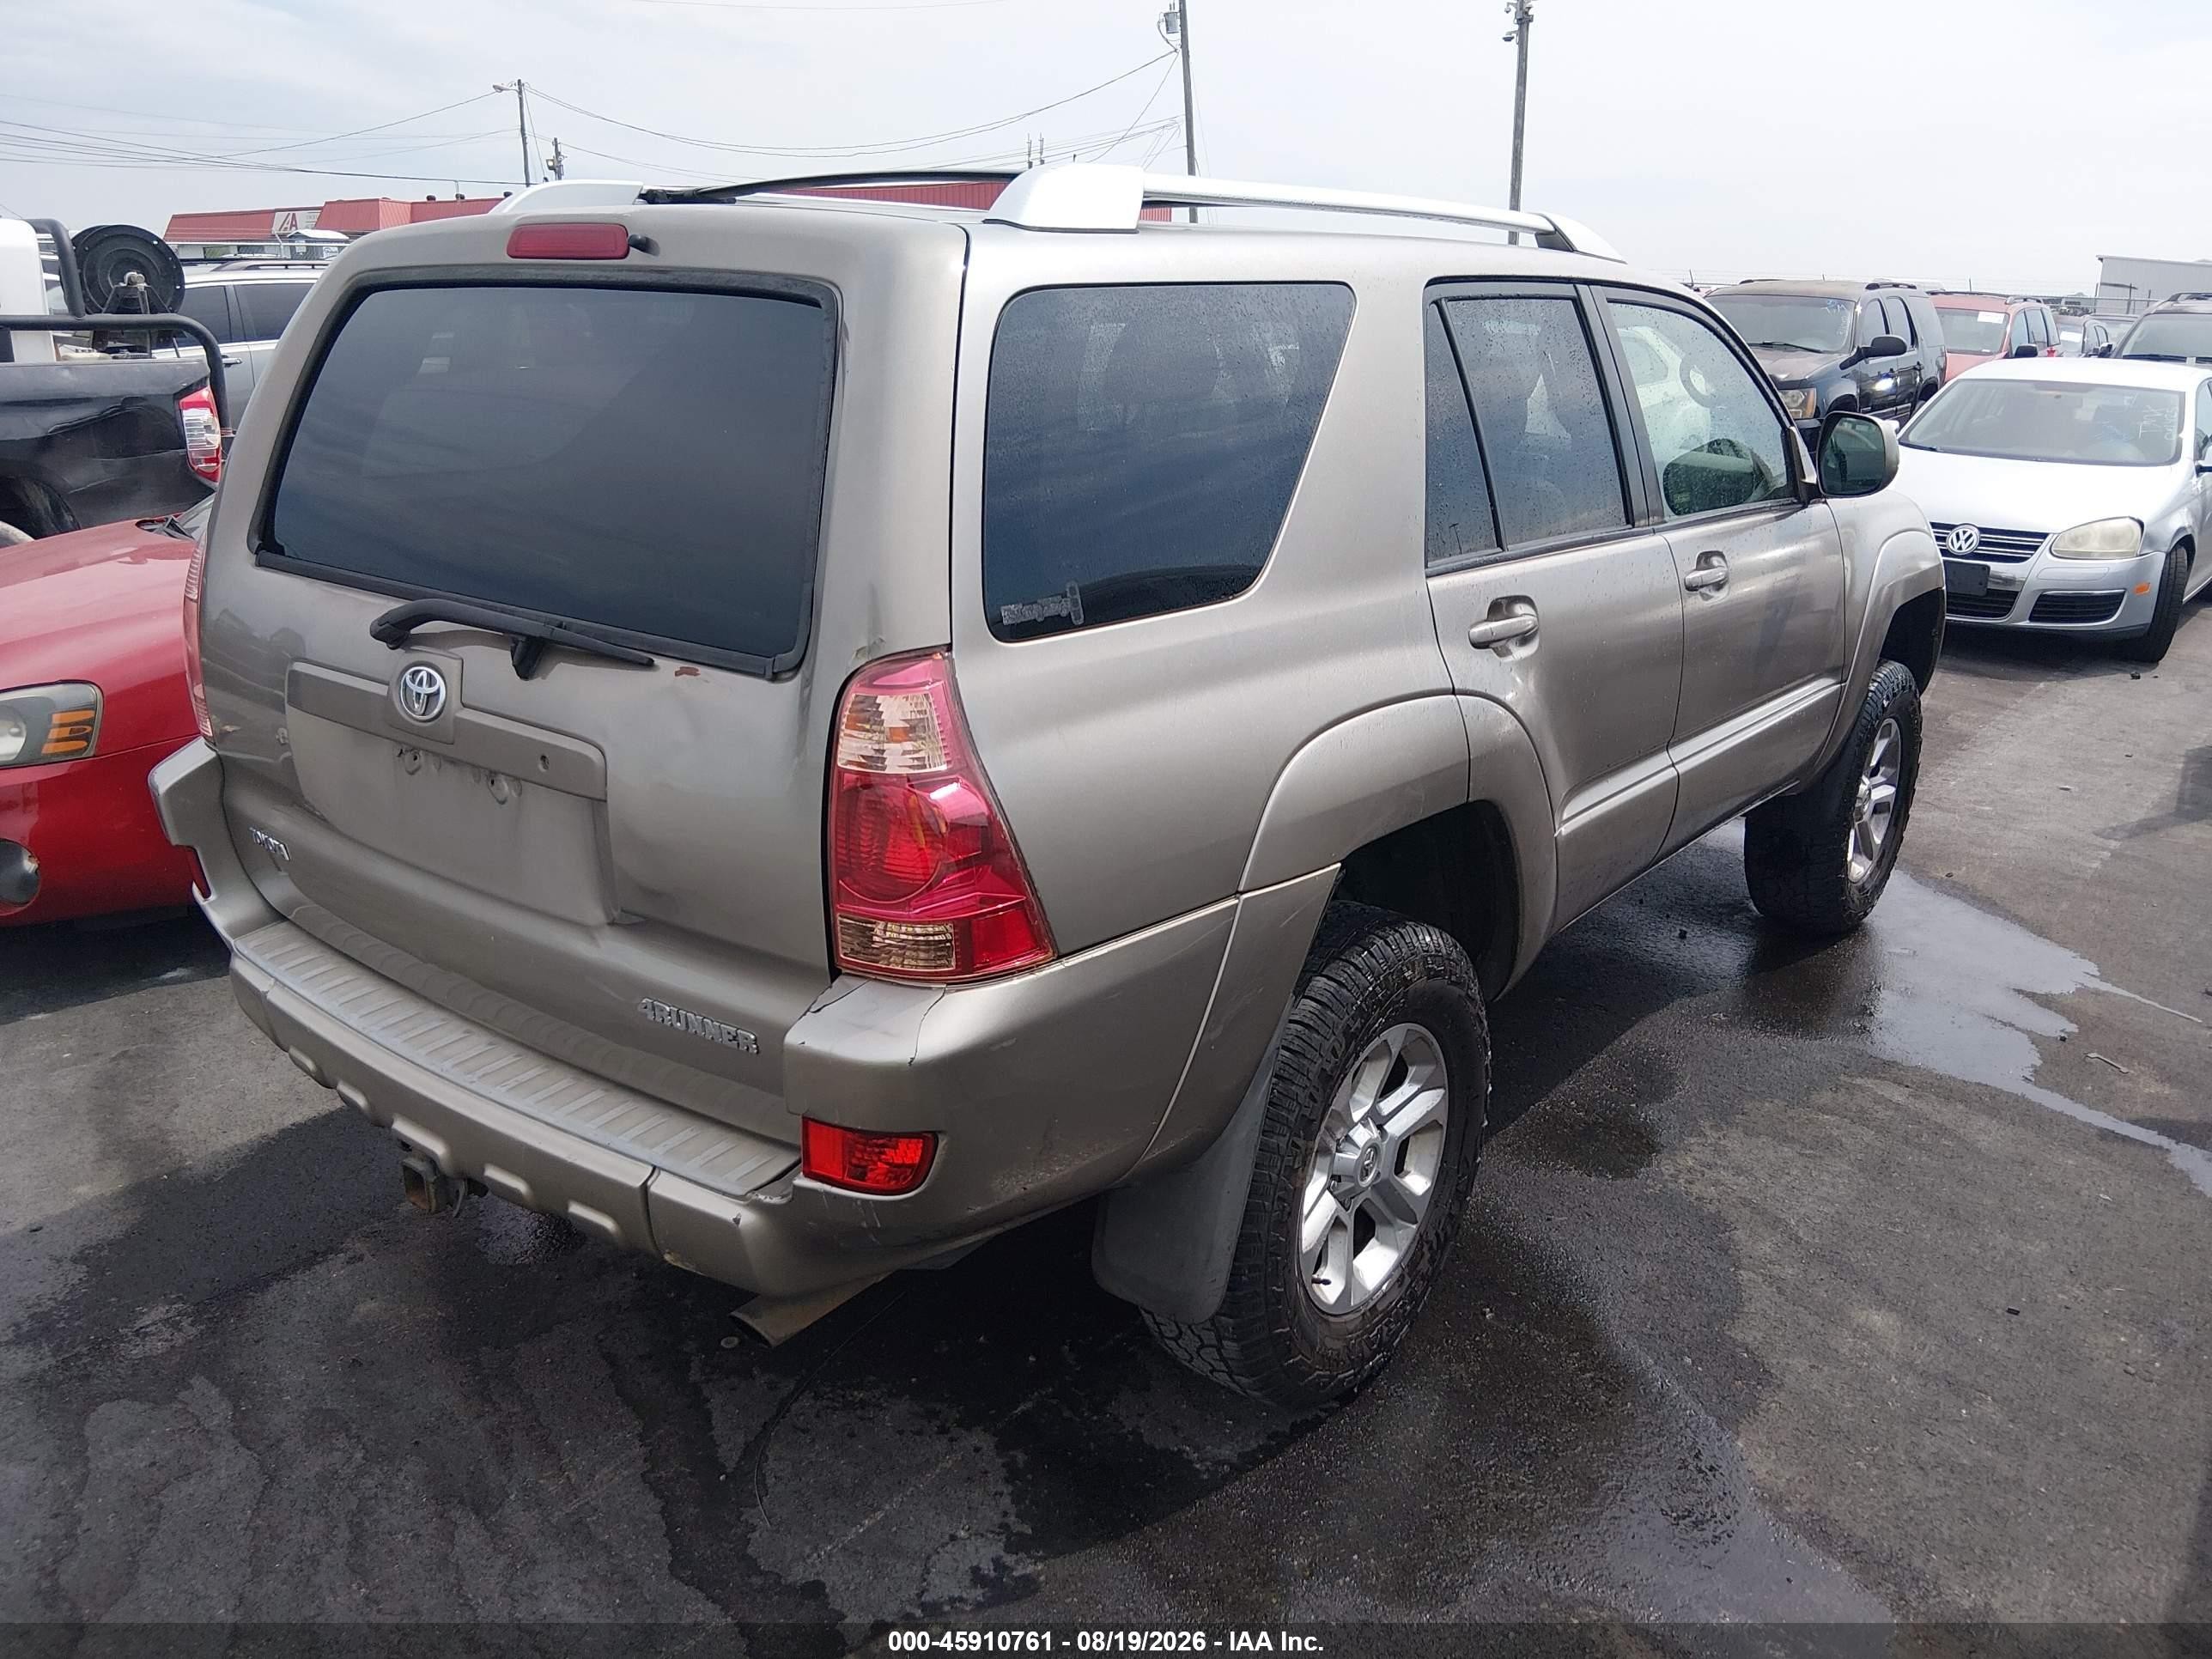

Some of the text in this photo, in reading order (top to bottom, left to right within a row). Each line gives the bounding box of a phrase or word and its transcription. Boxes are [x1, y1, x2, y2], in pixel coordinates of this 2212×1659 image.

[1947, 525, 1979, 554] VW
[249, 827, 290, 861] TOYOTA
[638, 997, 759, 1055] 4RUNNER
